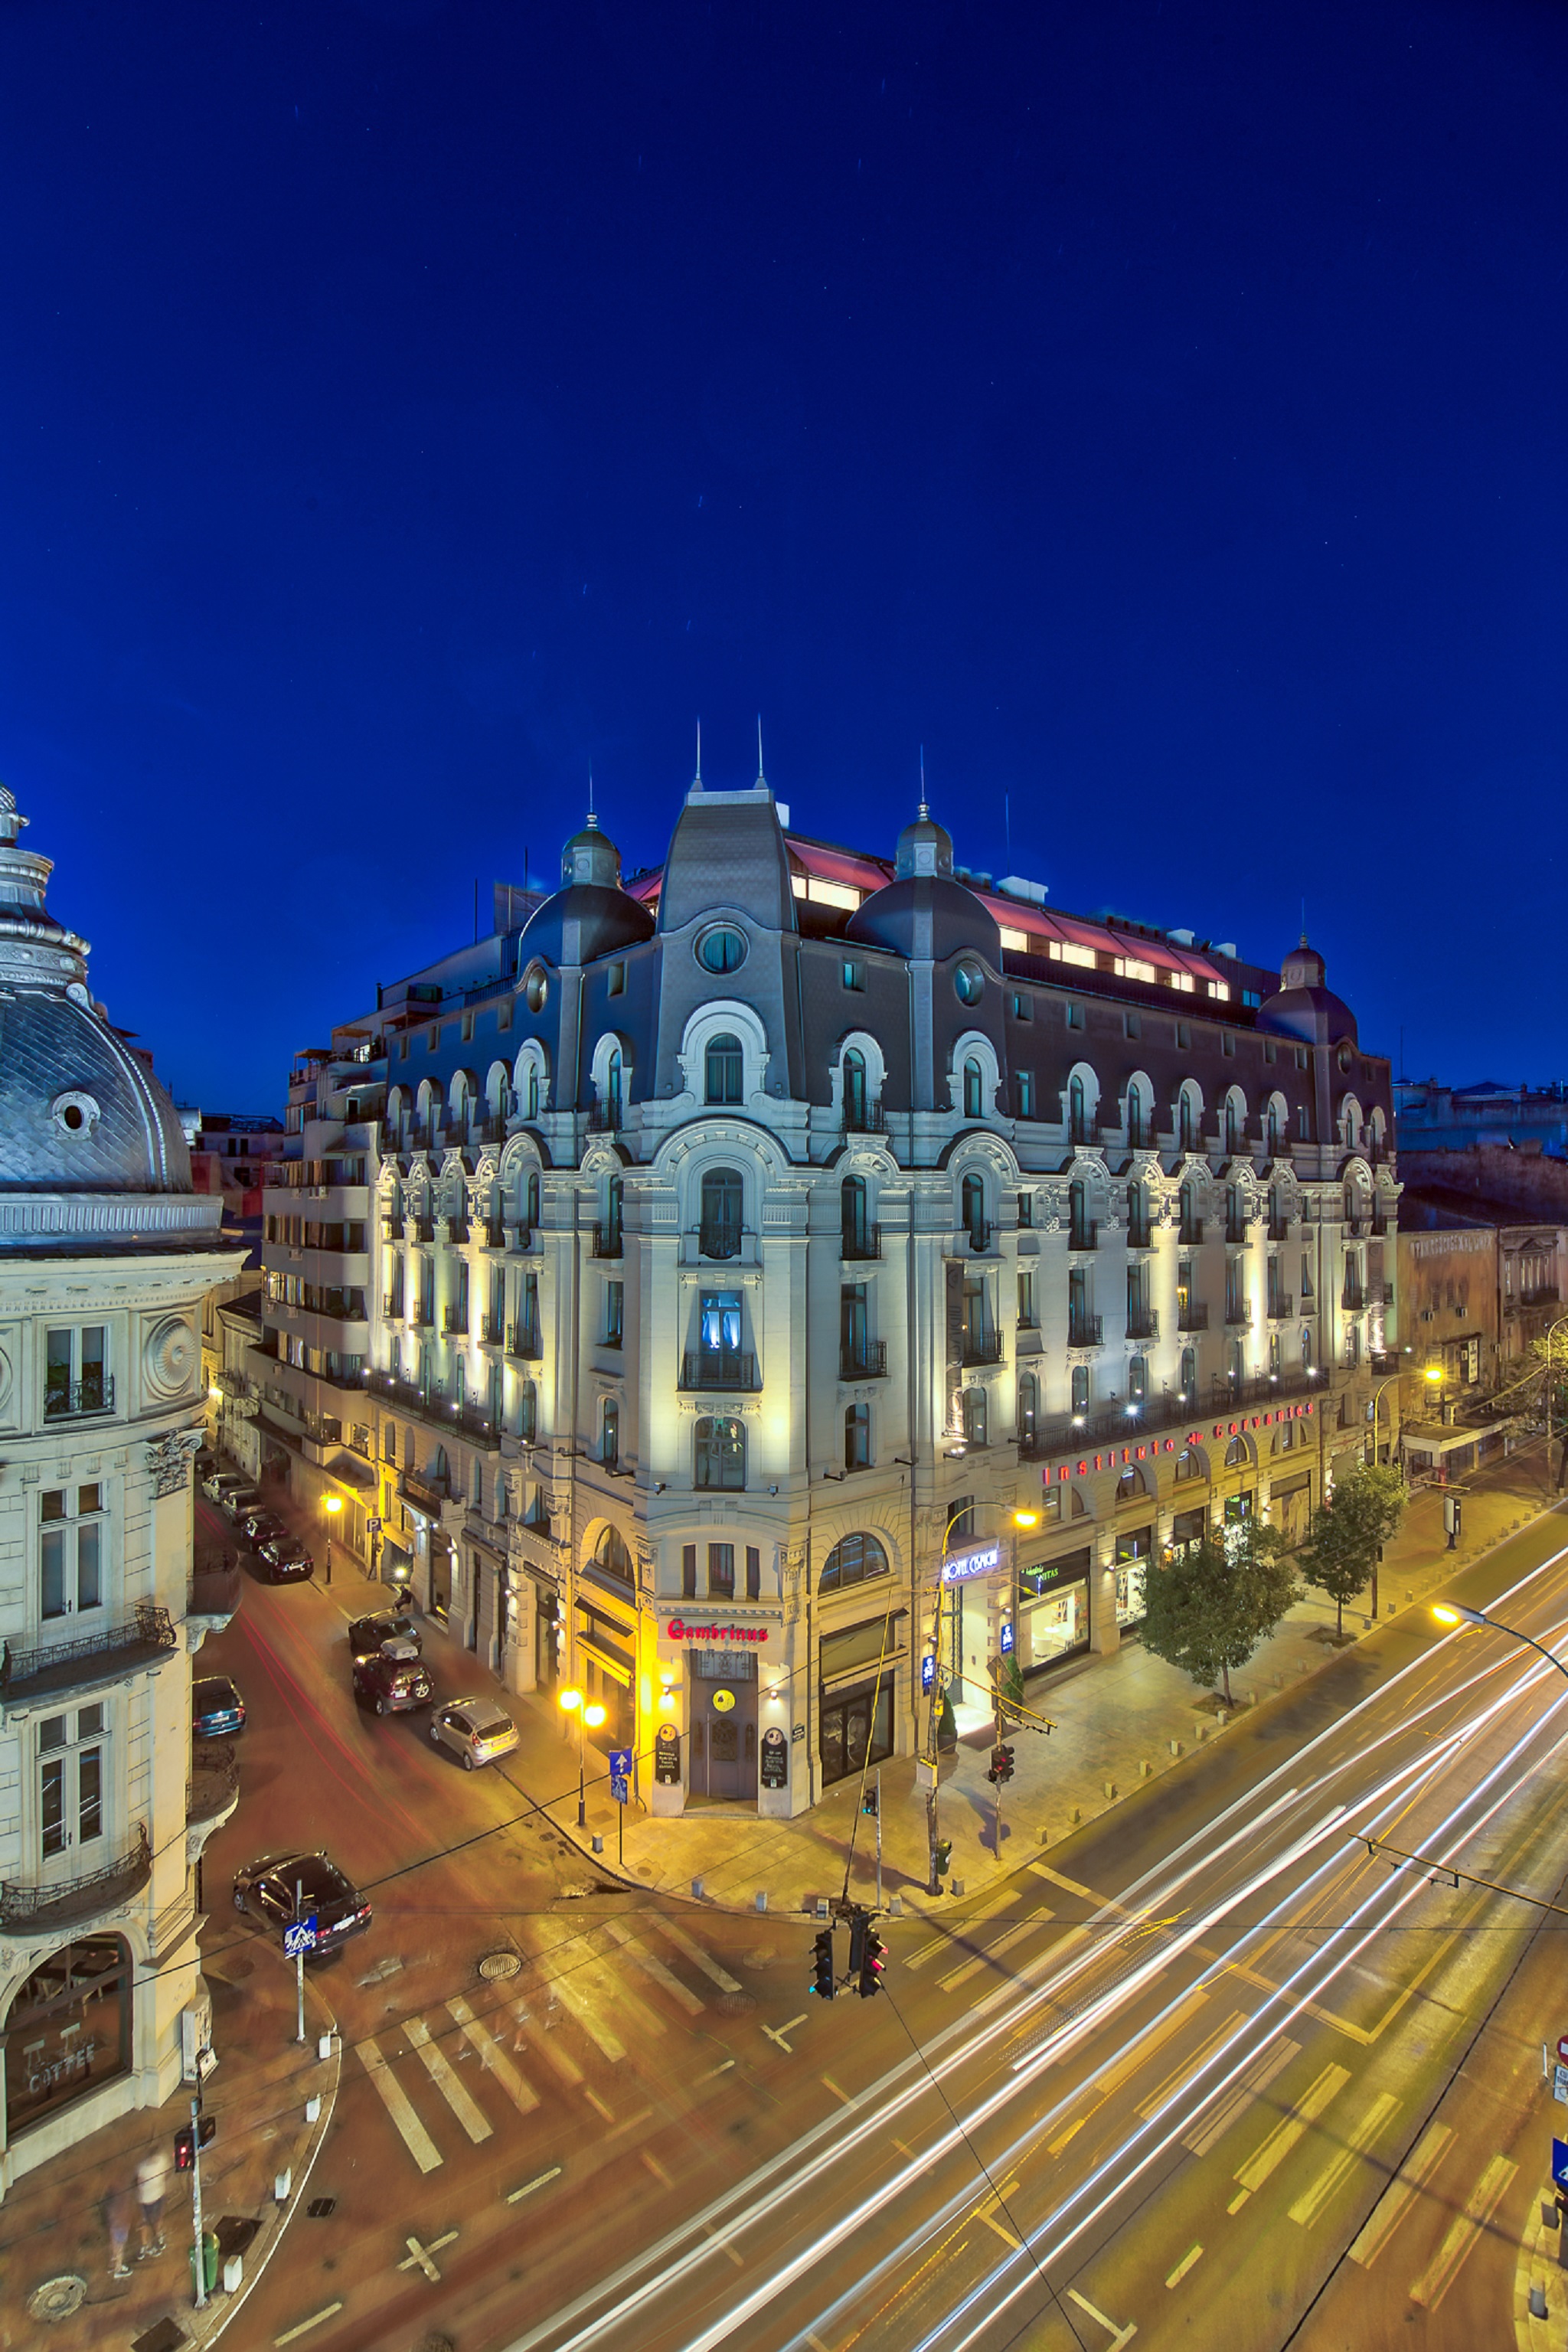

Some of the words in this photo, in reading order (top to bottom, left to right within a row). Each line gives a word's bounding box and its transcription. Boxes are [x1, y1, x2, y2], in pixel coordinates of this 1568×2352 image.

[1043, 1439, 1174, 1485] Instituto
[1213, 1403, 1313, 1439] Cervantes
[668, 1618, 769, 1642] Gambrinus
